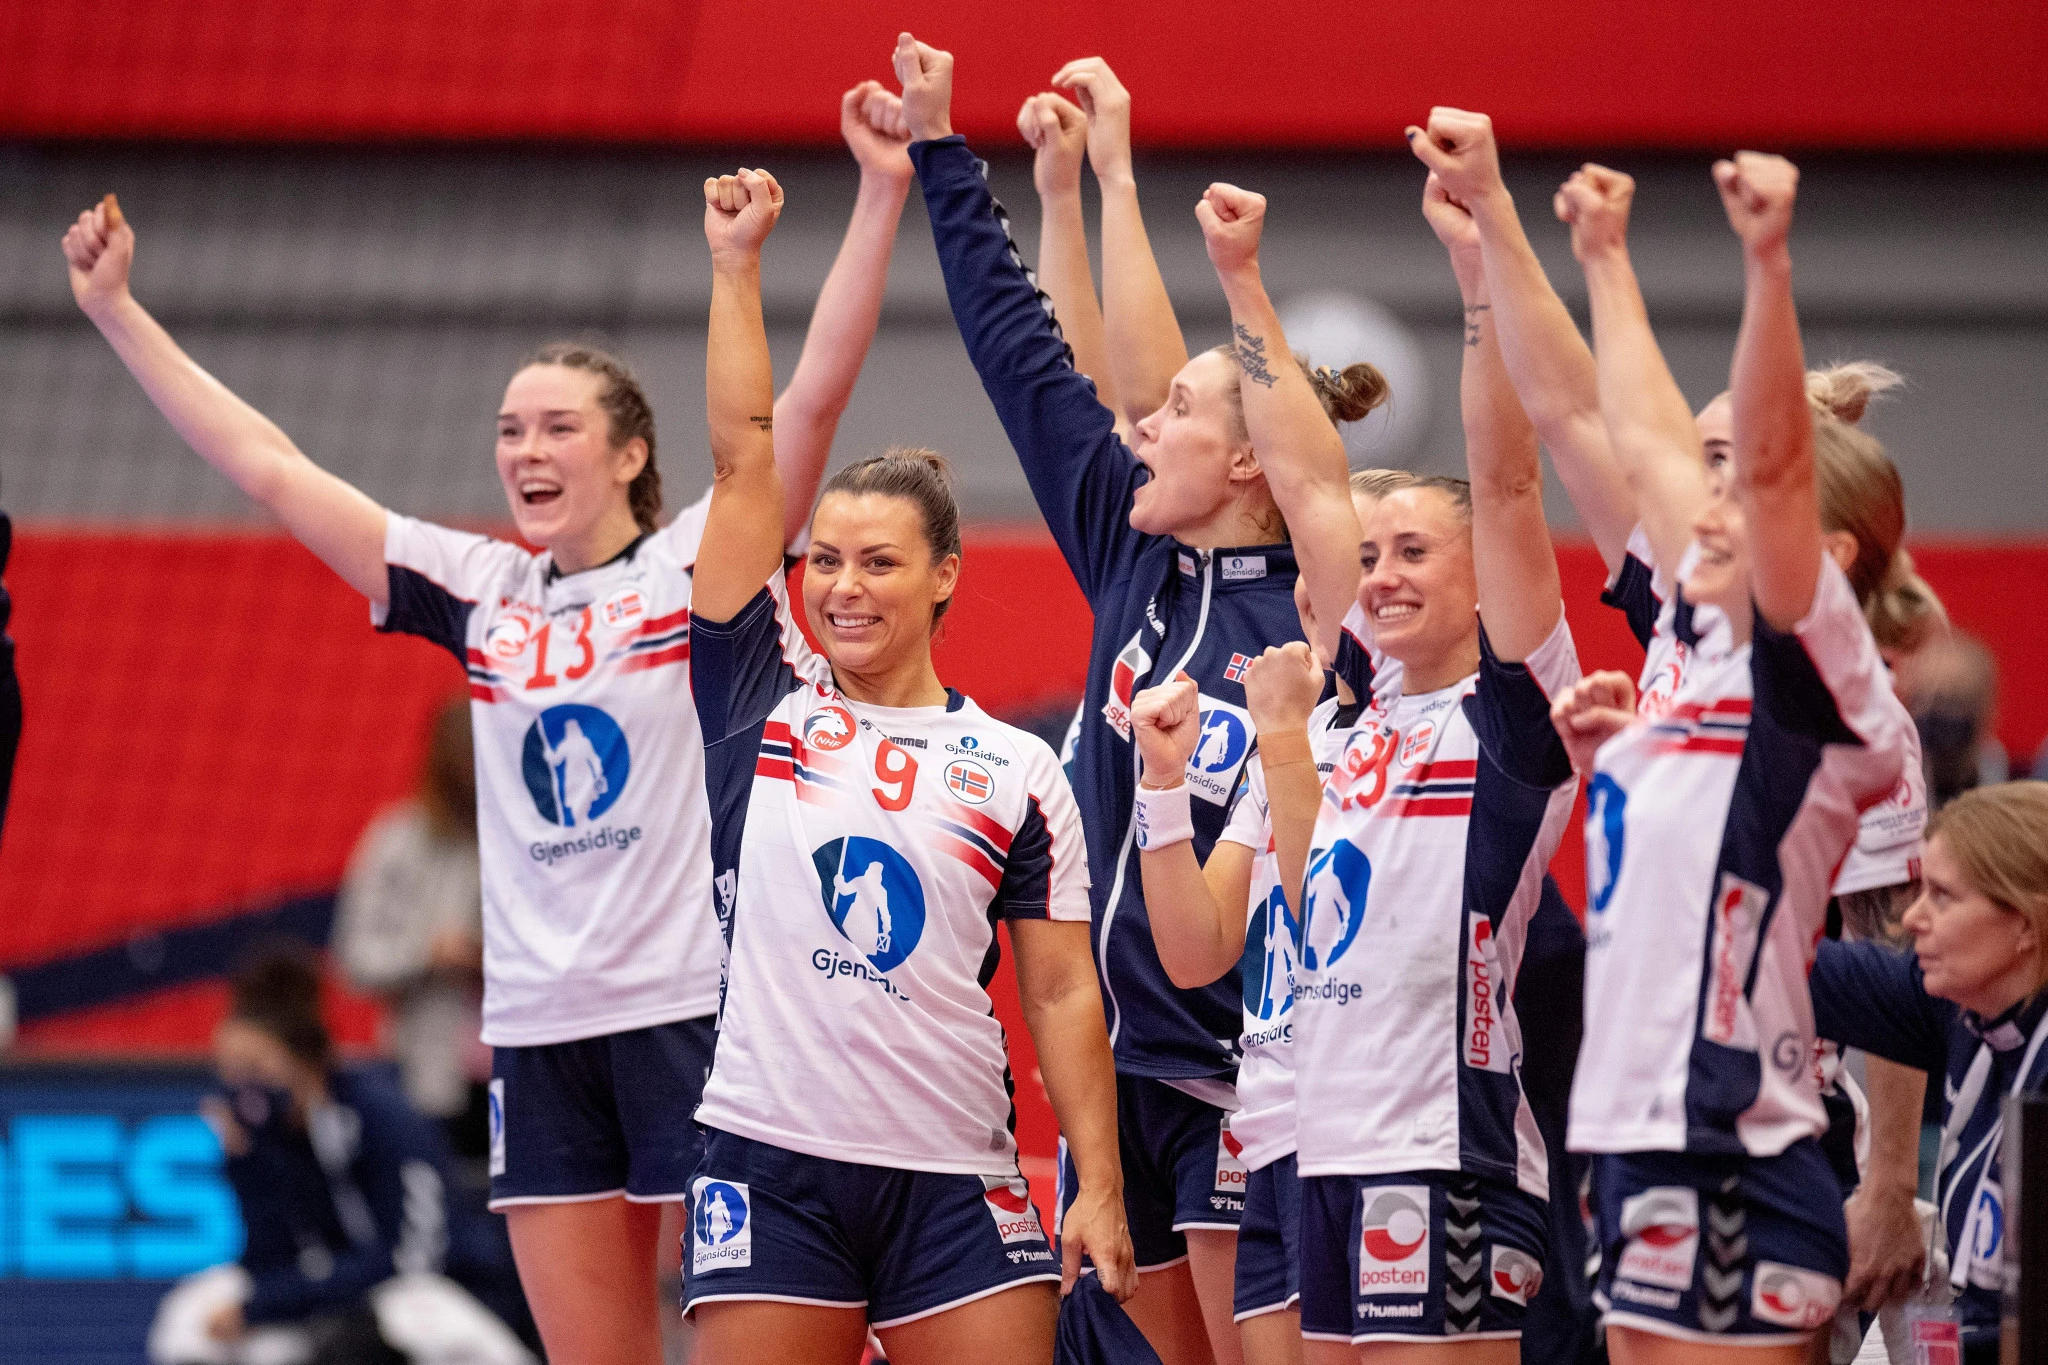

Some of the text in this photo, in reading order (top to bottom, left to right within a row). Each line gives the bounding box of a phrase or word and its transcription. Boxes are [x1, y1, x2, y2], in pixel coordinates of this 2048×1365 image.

[1223, 568, 1265, 578] Gjensidige
[524, 605, 595, 691] 13
[817, 735, 842, 748] NHF
[945, 743, 1009, 767] Gjensidige
[872, 739, 918, 811] 9
[1185, 772, 1227, 796] nsidige
[530, 824, 642, 867] Gjensidige
[1294, 977, 1363, 1006] ensidige
[1469, 960, 1495, 1066] posten
[1218, 1169, 1248, 1185] pos
[0, 1114, 246, 1278] ES
[999, 1218, 1042, 1239] posten
[694, 1246, 747, 1266] Gjensidige
[1361, 1267, 1425, 1288] posten
[1368, 1302, 1423, 1318] hummel
